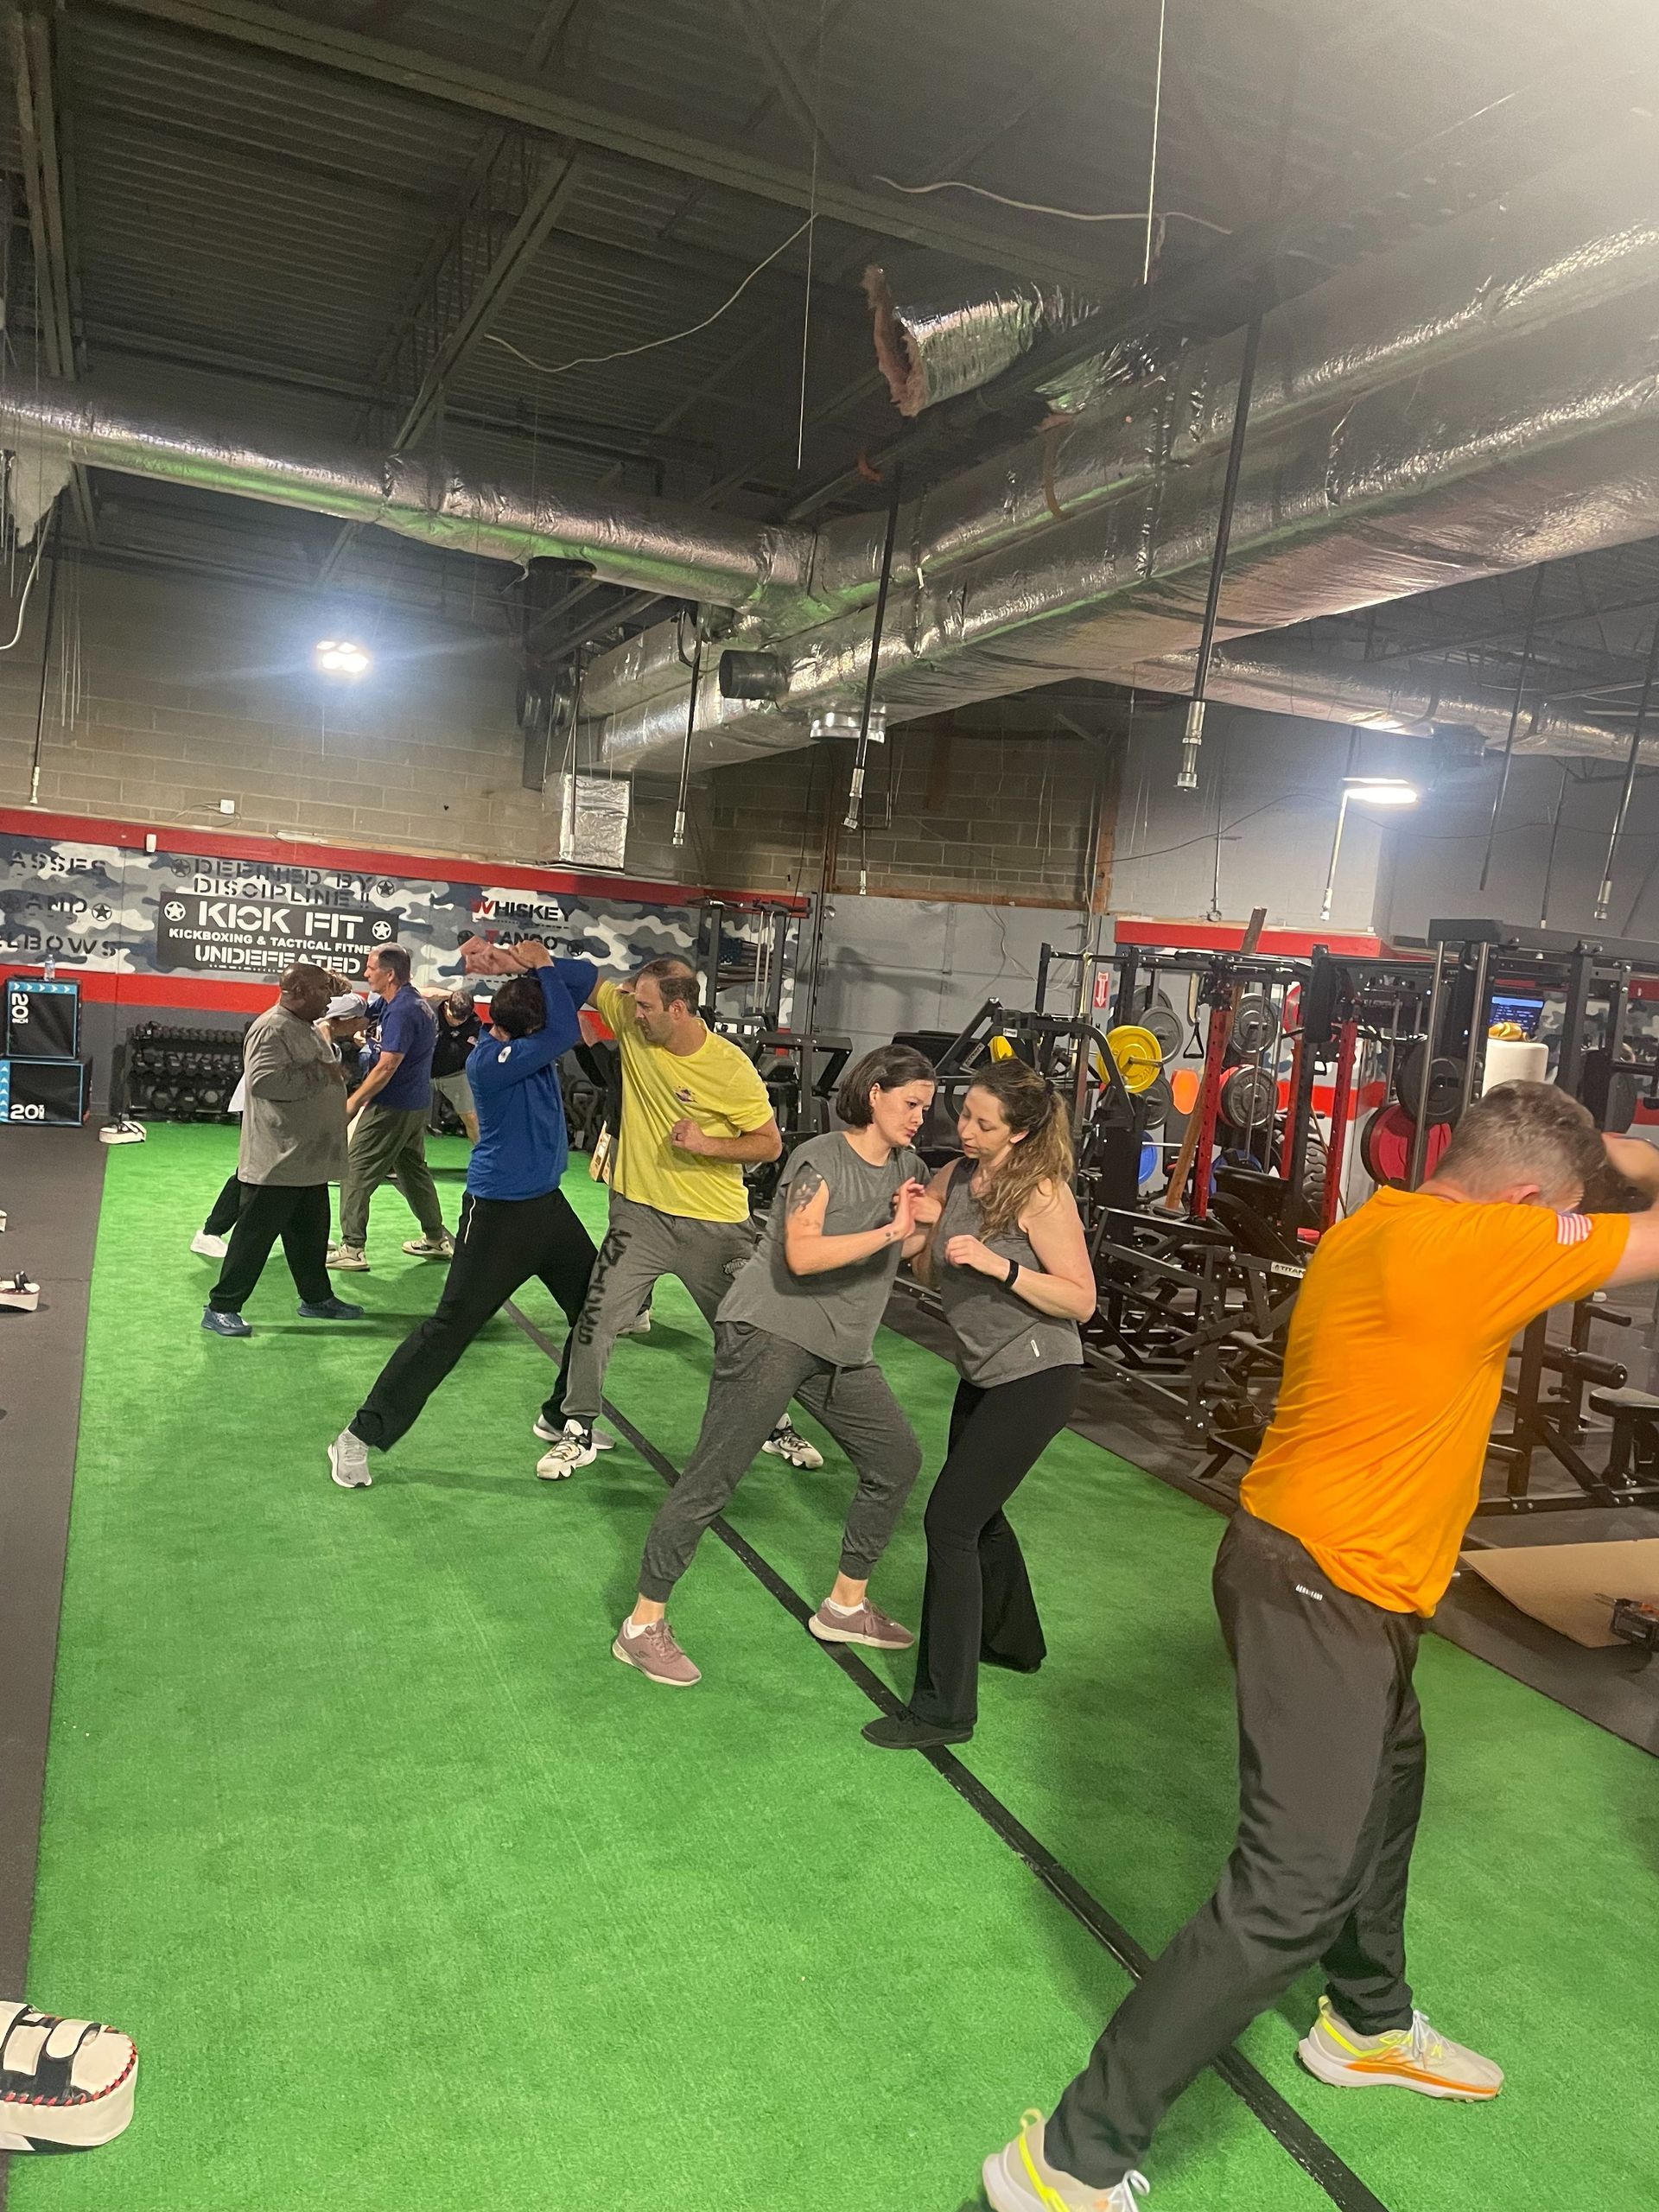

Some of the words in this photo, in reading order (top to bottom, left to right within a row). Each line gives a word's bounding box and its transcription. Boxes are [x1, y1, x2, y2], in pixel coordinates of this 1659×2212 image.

[194, 858, 321, 886] DEFINED
[336, 873, 373, 891] BY
[26, 893, 87, 913] AND
[194, 877, 350, 906] DISCIPLINE
[198, 900, 291, 934] KICK
[304, 912, 364, 940] FIT
[471, 899, 571, 922] WHISKEY
[0, 931, 117, 957] LBOWS
[168, 927, 253, 944] KICKBOXING
[257, 935, 267, 945] &
[270, 937, 332, 951] TACTICAL
[334, 942, 372, 955] FITNE
[194, 944, 361, 974] UNDEFEATED
[11, 992, 29, 1019] 20
[10, 1103, 39, 1120] 20
